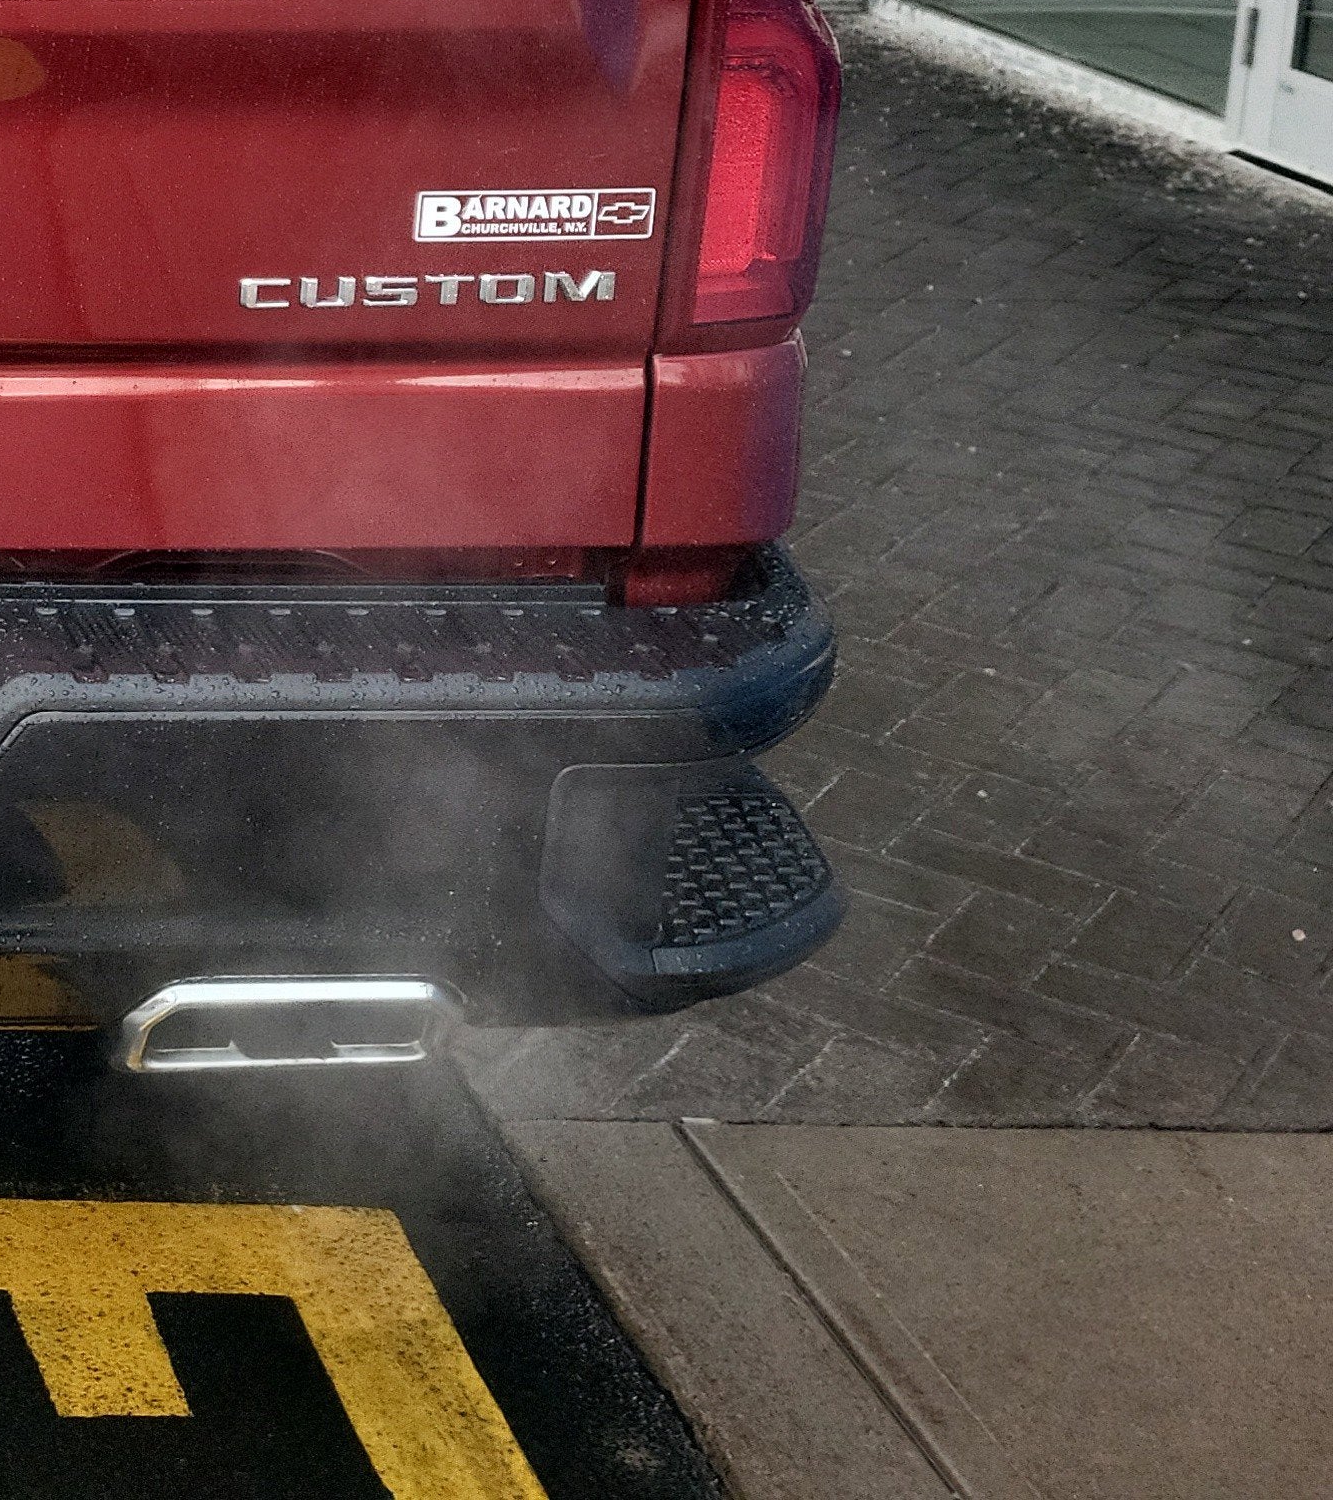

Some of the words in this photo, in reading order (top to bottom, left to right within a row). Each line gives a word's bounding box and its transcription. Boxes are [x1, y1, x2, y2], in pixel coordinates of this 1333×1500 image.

[419, 194, 593, 237] BARNARD
[460, 220, 562, 235] CHURCHVILLE,
[564, 220, 588, 233] N.Y.
[239, 269, 617, 309] CUSTOM
